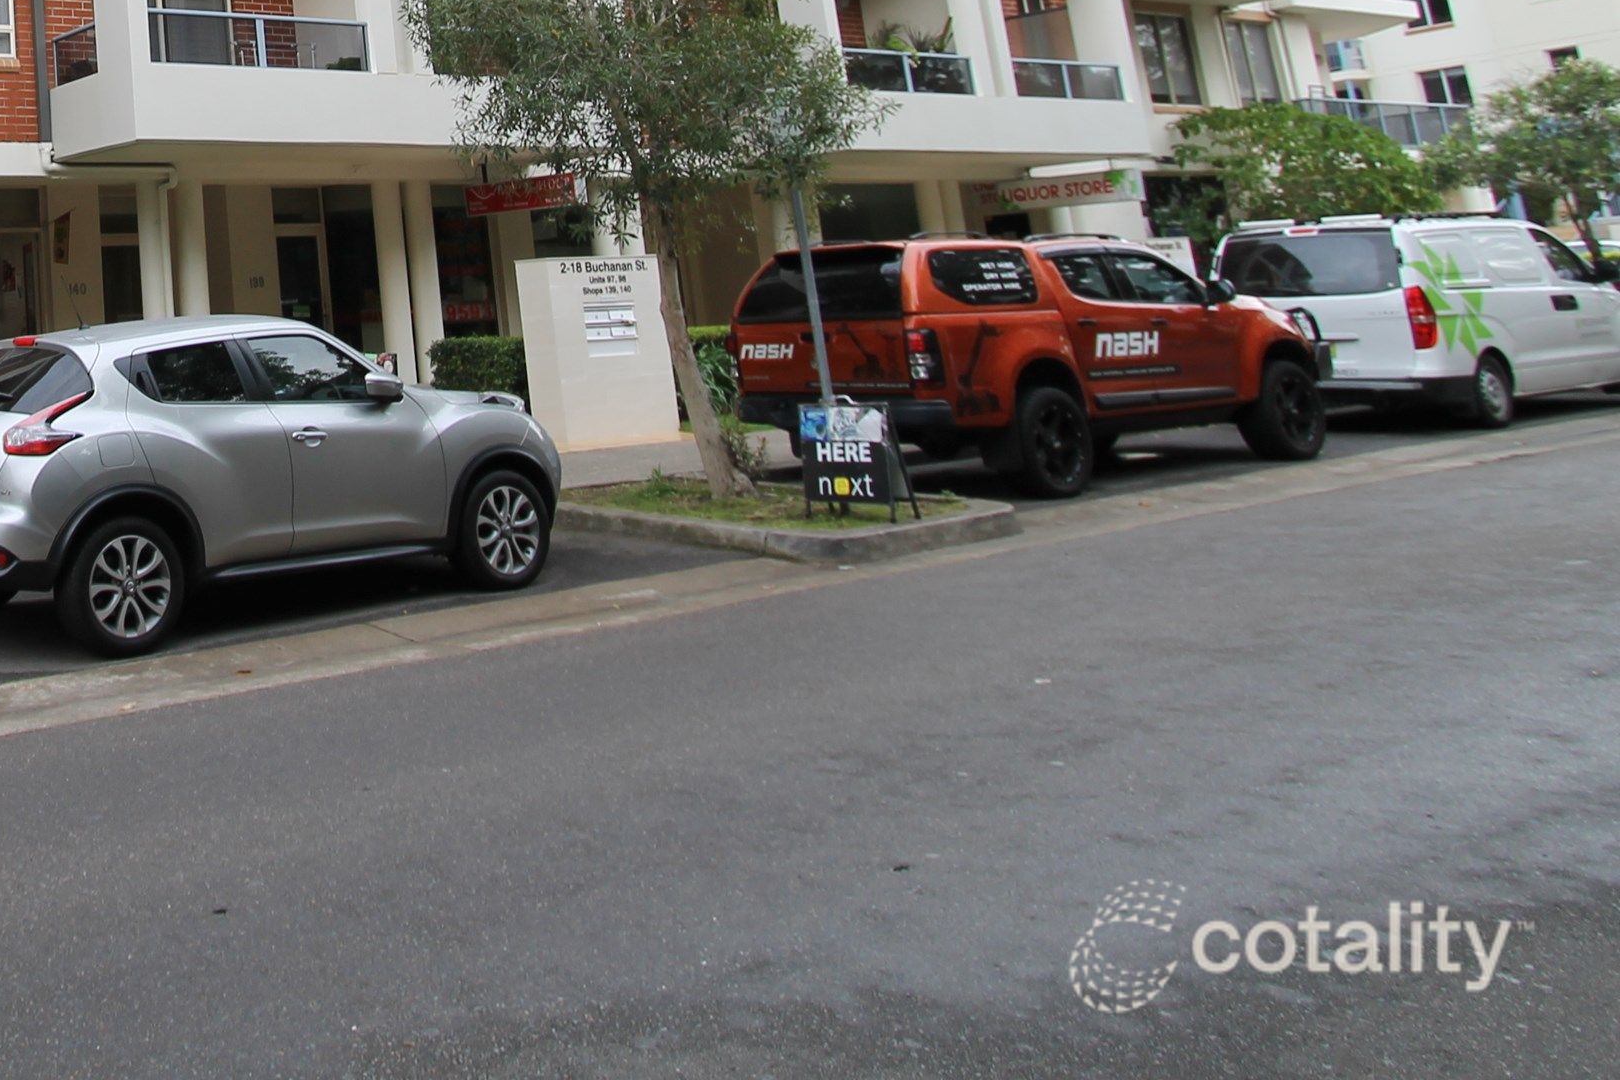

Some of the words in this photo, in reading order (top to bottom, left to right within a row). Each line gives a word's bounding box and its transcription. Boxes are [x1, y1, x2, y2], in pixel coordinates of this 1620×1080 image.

[1004, 185, 1059, 203] LIQUOR
[1065, 180, 1113, 197] STORE
[560, 262, 582, 274] 2-18
[585, 261, 634, 273] Buchanan
[635, 260, 648, 271] St.
[996, 261, 1016, 269] HIRE
[589, 276, 605, 284] Units
[1000, 271, 1020, 279] HIRE
[583, 287, 604, 296] Shops
[605, 286, 619, 294] 139,
[620, 285, 632, 293] 140
[961, 283, 1003, 291] OPERATOR
[1003, 282, 1023, 290] HIRE
[816, 442, 873, 463] HERE
